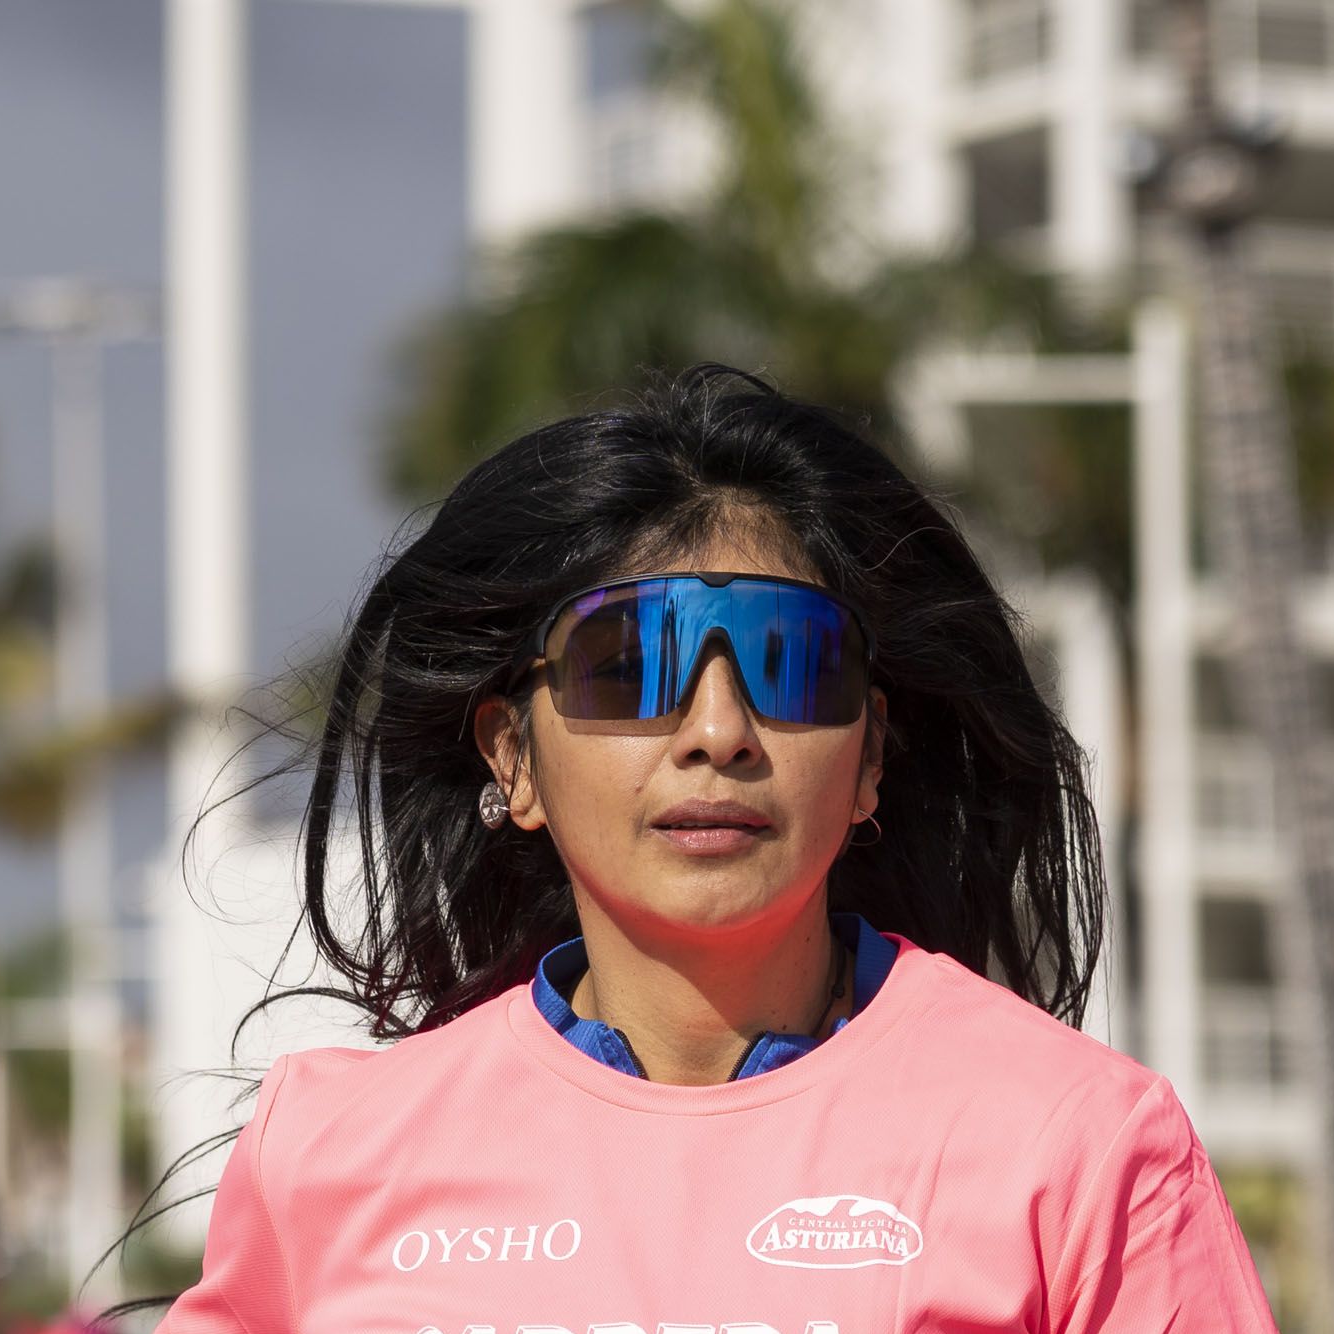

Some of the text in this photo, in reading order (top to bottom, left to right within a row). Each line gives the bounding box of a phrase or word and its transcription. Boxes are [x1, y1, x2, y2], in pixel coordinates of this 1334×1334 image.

[758, 1222, 909, 1256] ASTURIANA
[788, 1216, 908, 1235] CENTRAL LECHERA
[392, 1218, 582, 1272] OYSHO
